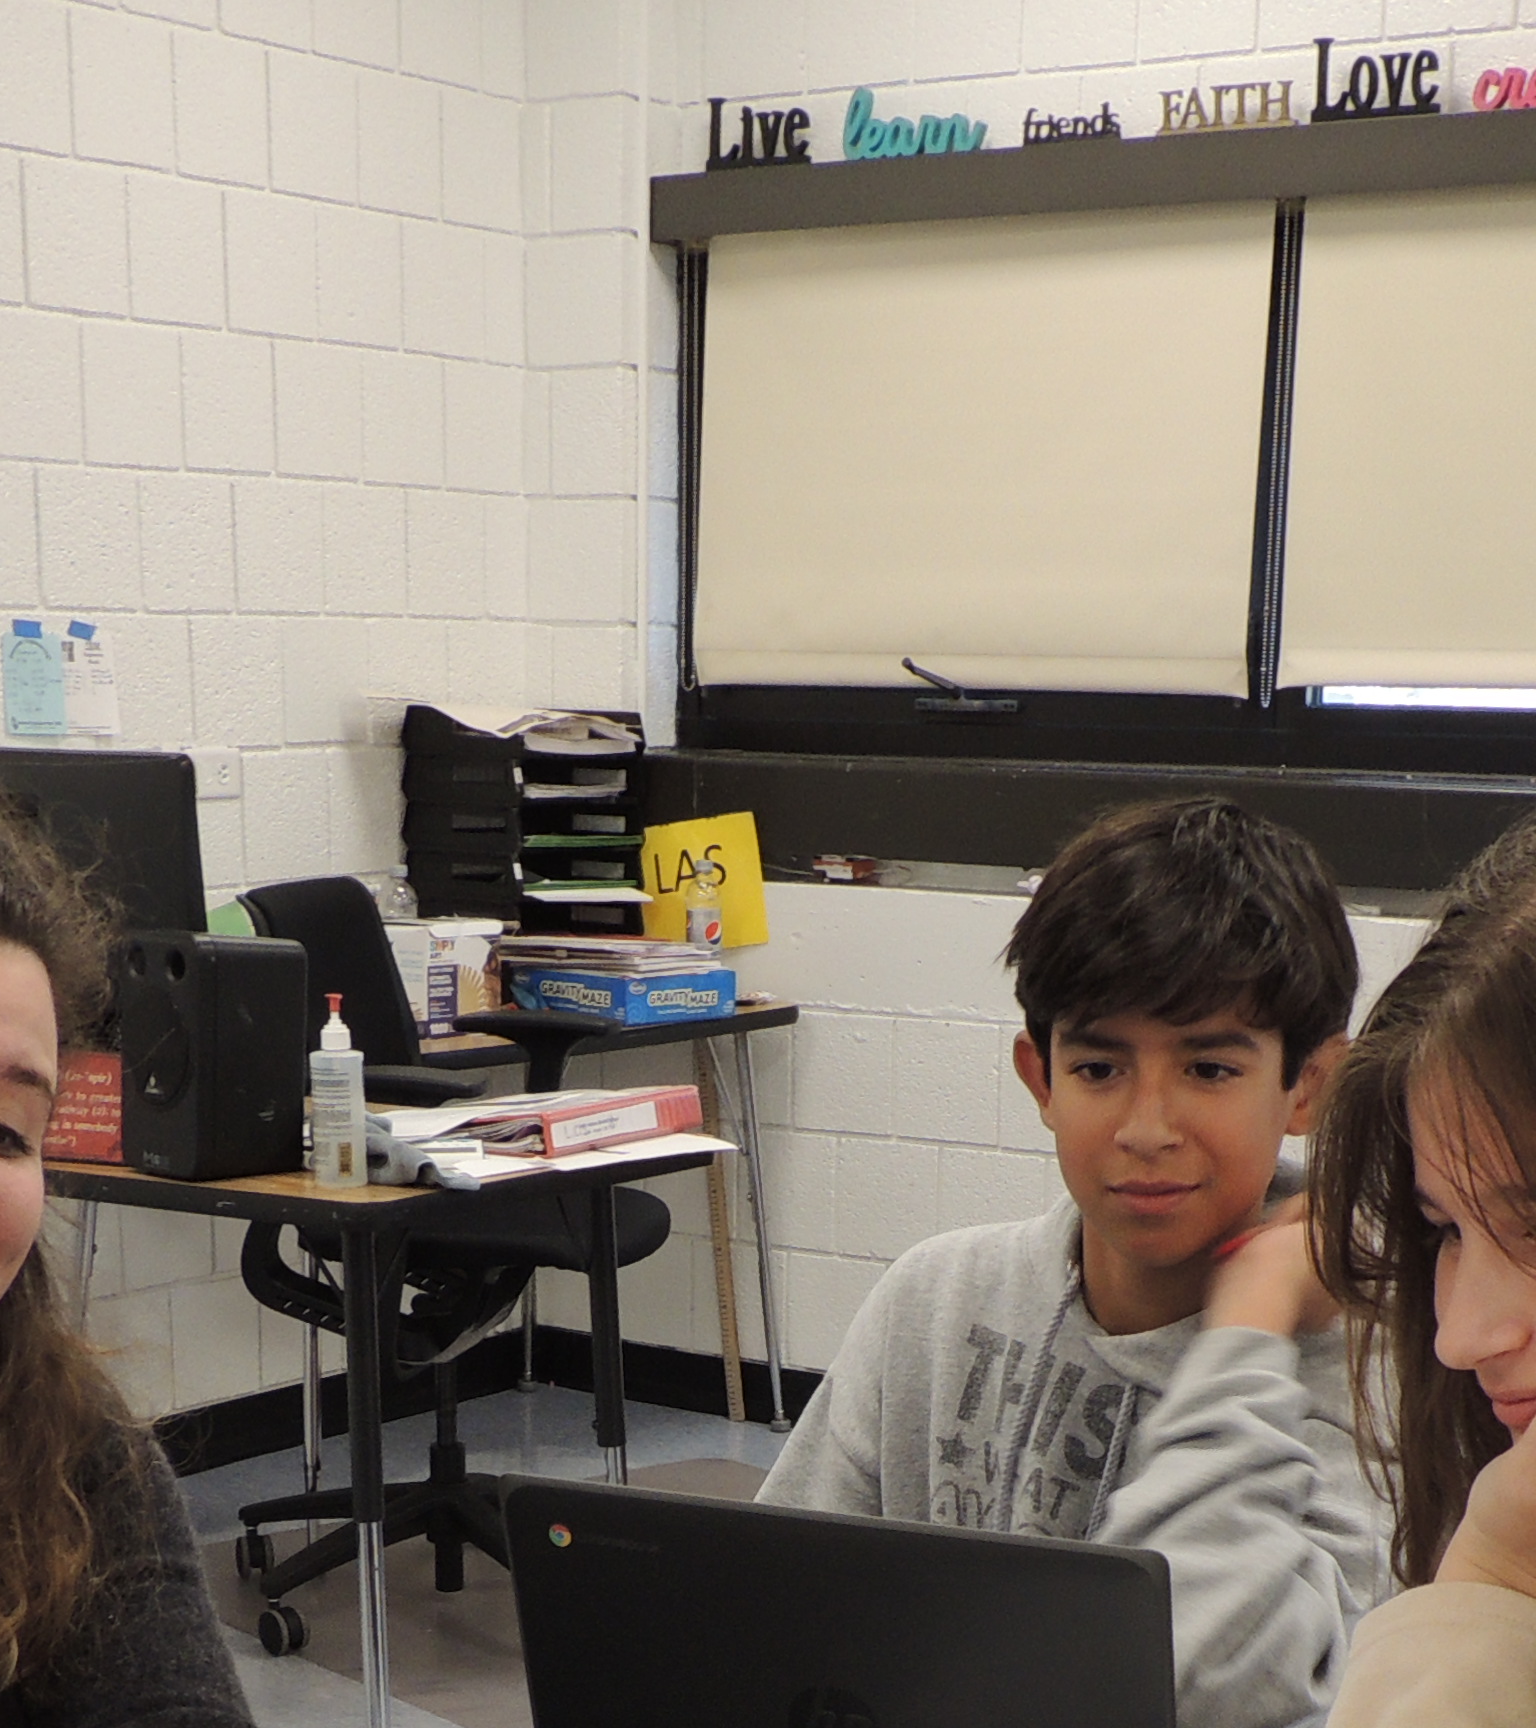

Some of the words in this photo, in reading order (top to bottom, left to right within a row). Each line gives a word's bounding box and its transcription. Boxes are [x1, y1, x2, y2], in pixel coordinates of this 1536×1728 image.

[1311, 38, 1440, 120] Love
[843, 87, 987, 161] learn
[1023, 102, 1121, 147] friends
[1158, 80, 1296, 134] FAITH
[706, 97, 811, 170] Live
[654, 844, 727, 894] LAS
[541, 980, 583, 999] GRAVITY
[580, 989, 612, 1006] MAZE
[648, 989, 690, 1006] GRAVITY
[688, 990, 718, 1006] MAZE
